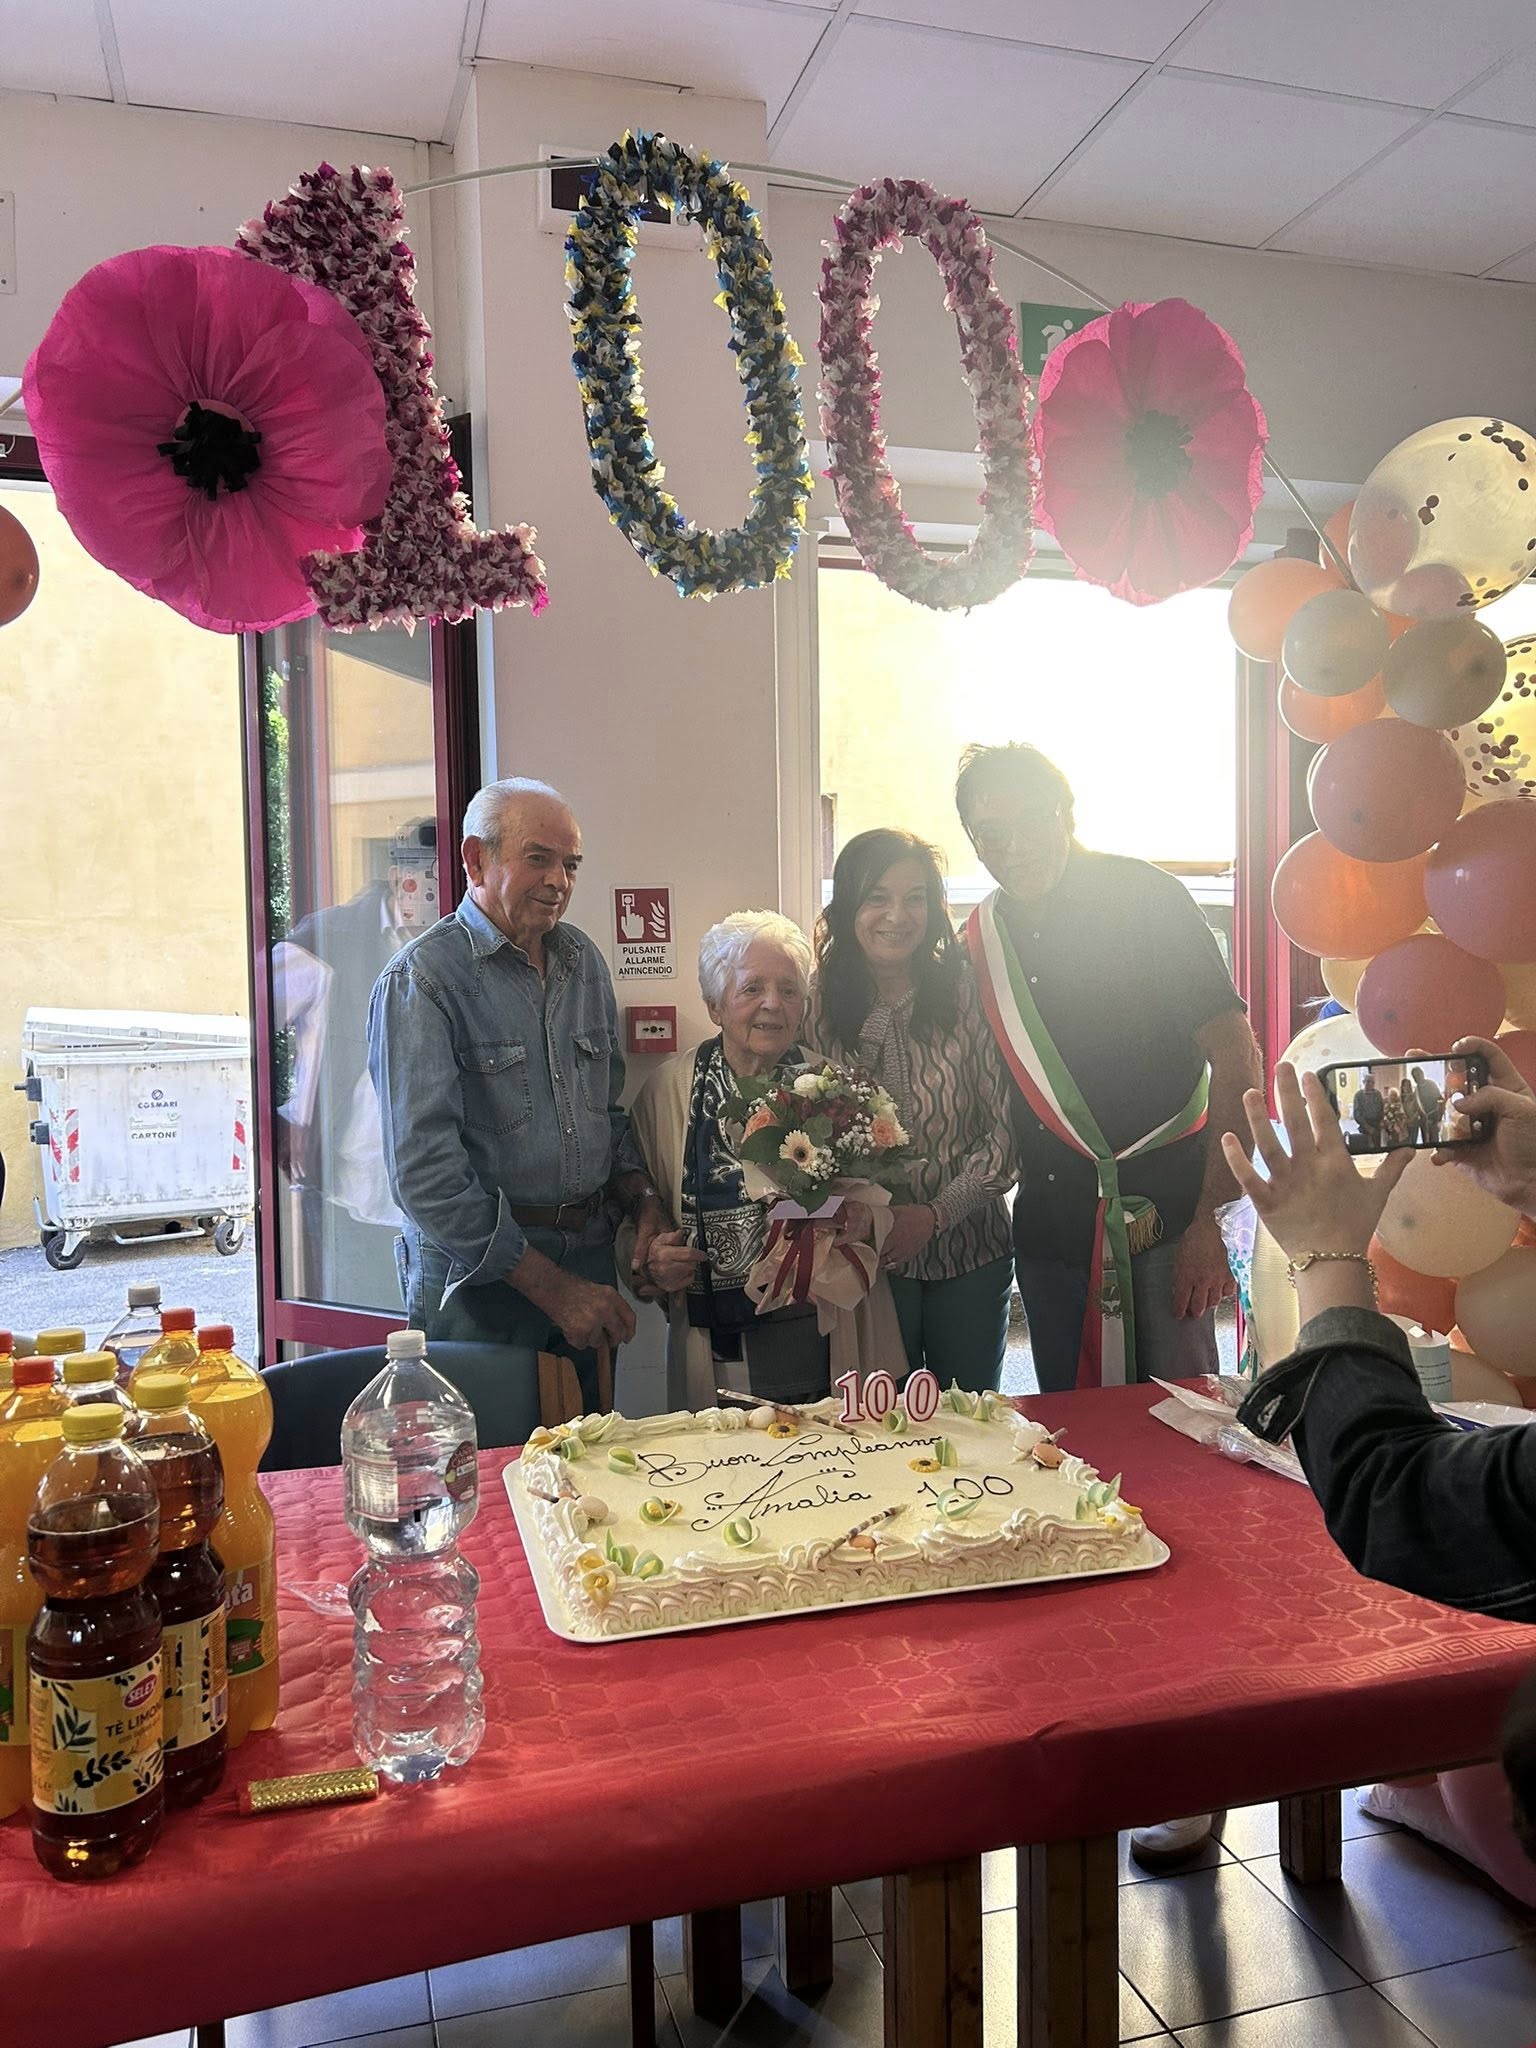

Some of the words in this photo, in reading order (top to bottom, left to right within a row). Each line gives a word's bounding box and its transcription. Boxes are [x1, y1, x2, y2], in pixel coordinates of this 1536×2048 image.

[622, 945, 666, 954] PULSANTE
[625, 956, 665, 965] ALLARME
[619, 966, 672, 975] ANTINCENDIO
[137, 1101, 178, 1109] COSMARI
[835, 1369, 940, 1423] 100
[637, 1453, 761, 1488] Buon
[691, 1469, 872, 1532] Amalia
[917, 1475, 1014, 1507] 100
